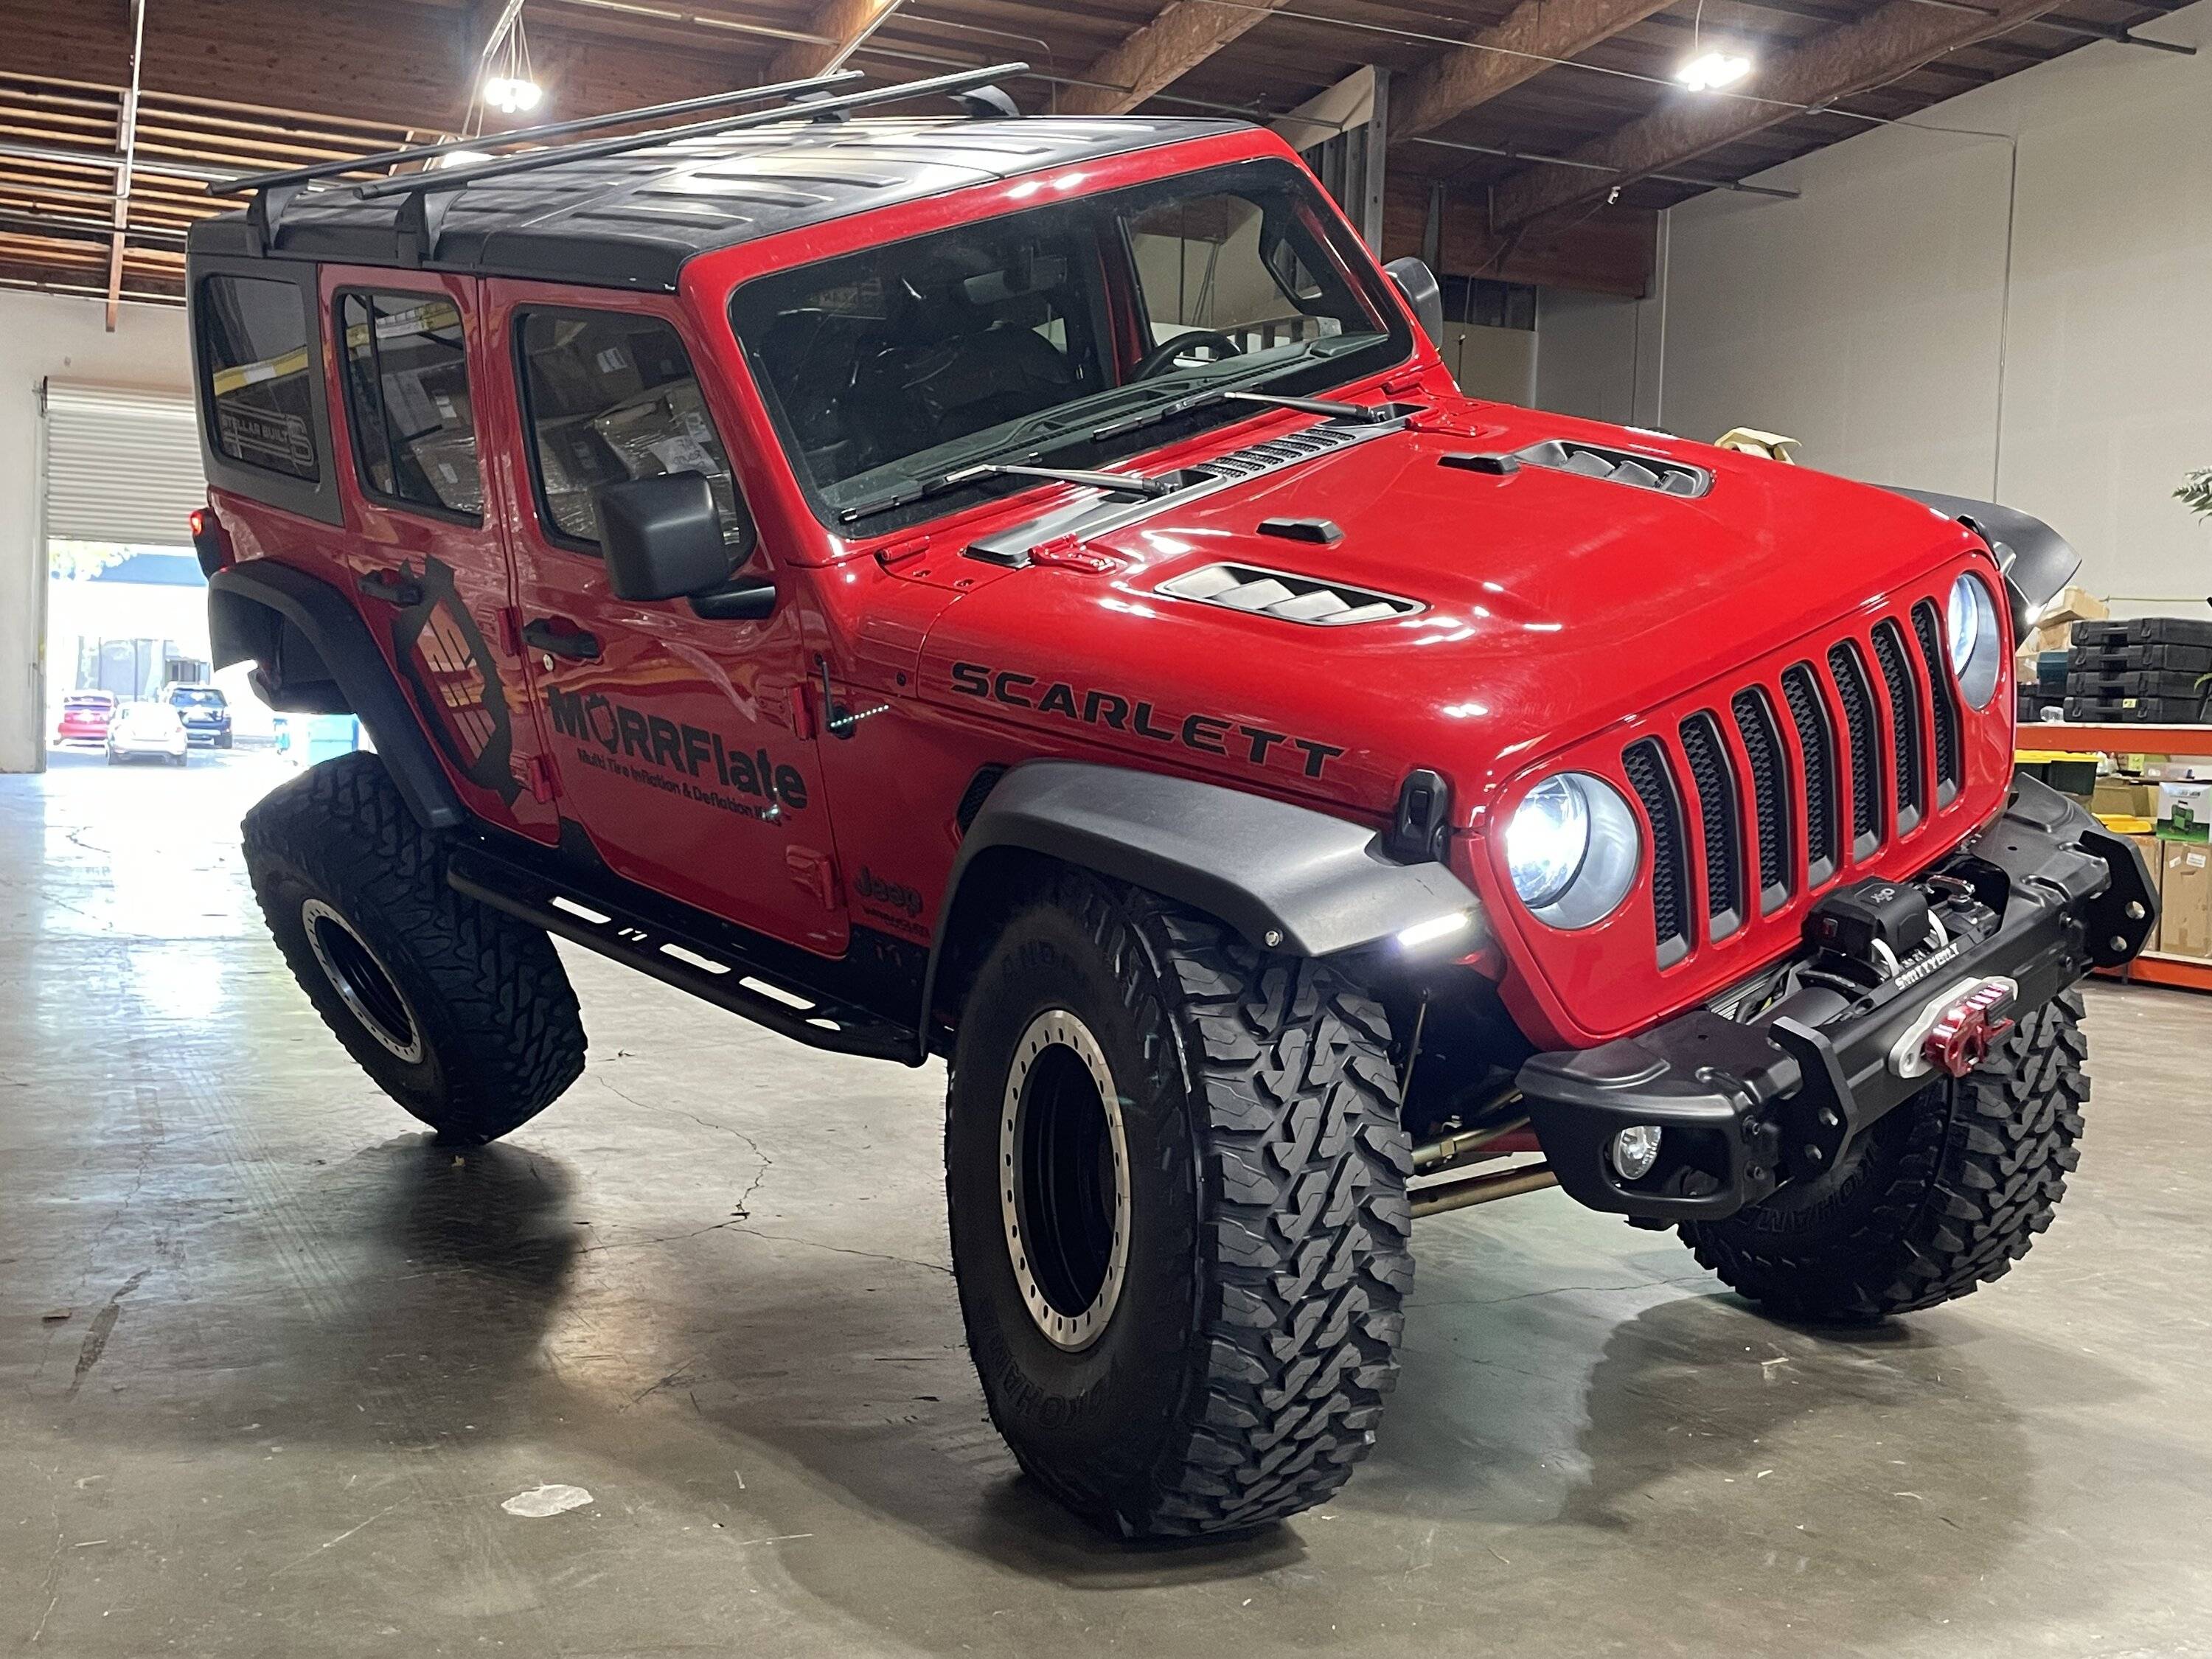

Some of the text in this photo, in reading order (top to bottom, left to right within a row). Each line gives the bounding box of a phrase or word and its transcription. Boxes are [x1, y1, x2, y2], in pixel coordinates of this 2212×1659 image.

[951, 661, 1344, 779] SCARLETT
[577, 747, 605, 770] Multi
[608, 757, 629, 777] Tire
[630, 765, 681, 796] Inflation
[682, 782, 694, 800] &
[694, 786, 753, 818] Deflation
[853, 865, 923, 918] Jeep
